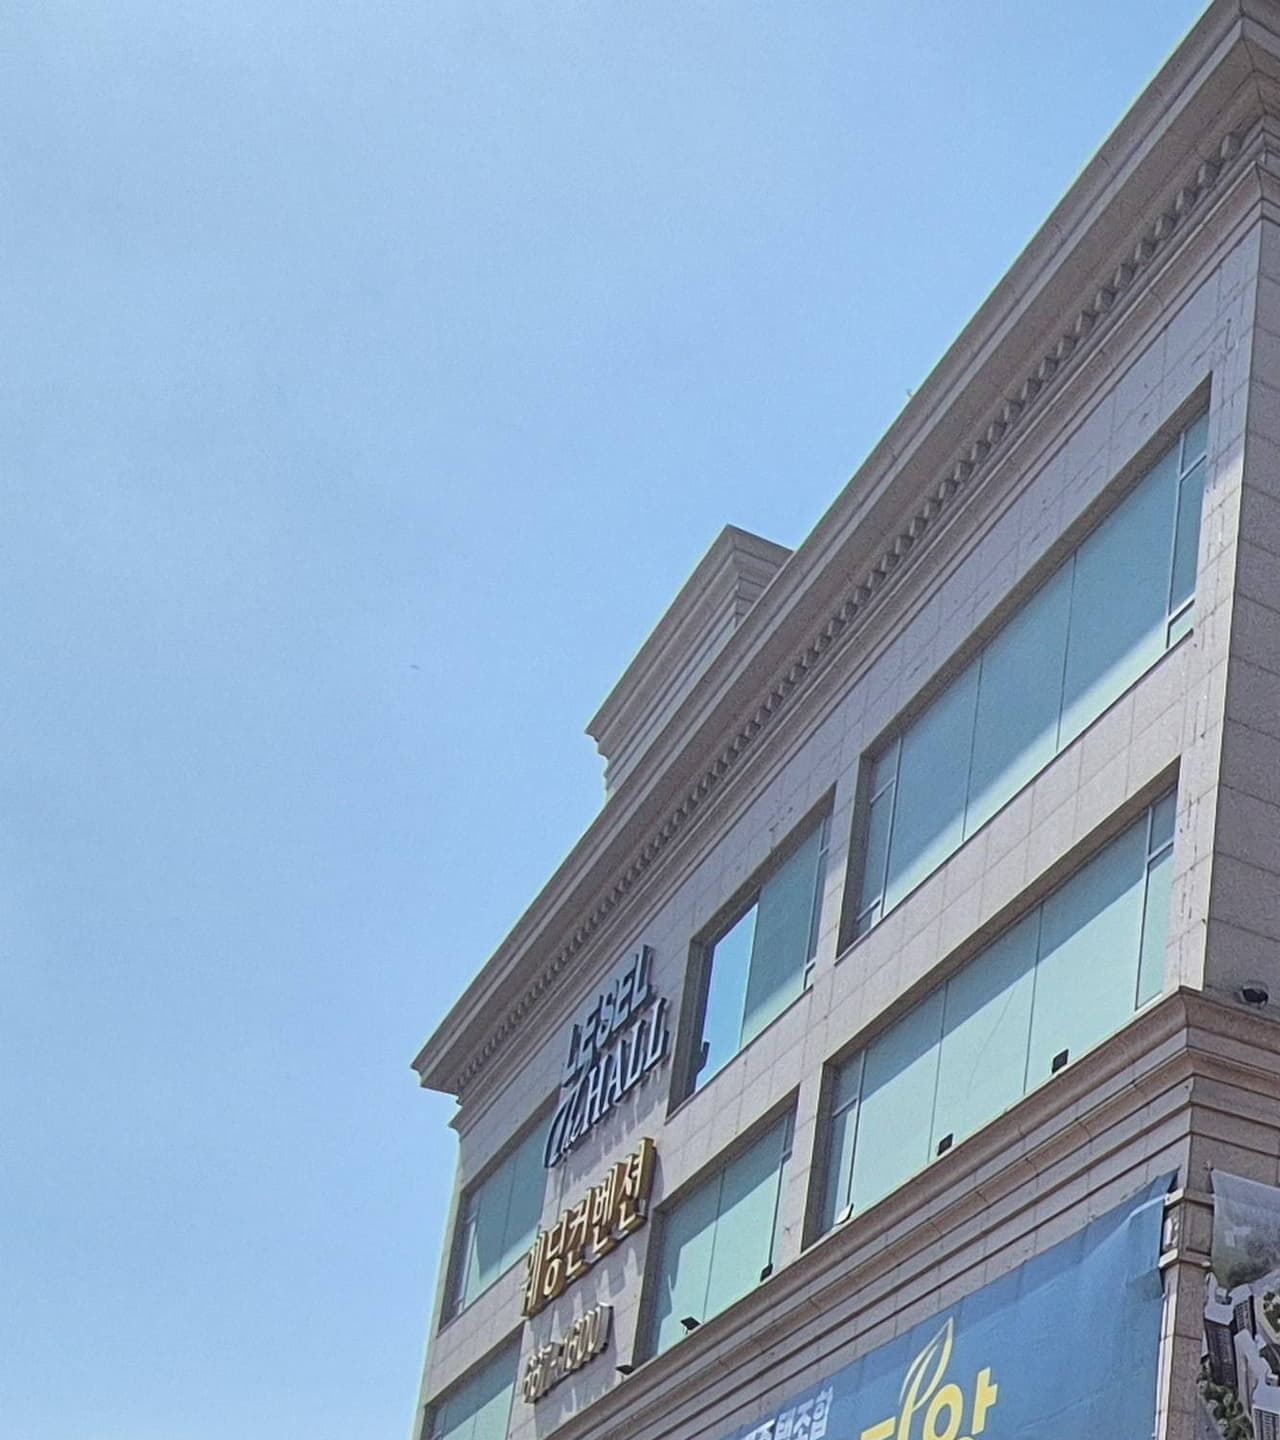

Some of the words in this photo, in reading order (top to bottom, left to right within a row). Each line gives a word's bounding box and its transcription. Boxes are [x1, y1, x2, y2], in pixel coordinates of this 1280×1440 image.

[562, 944, 652, 1083] LESEL
[581, 997, 669, 1136] HALL
[521, 1137, 656, 1319] 웨딩컨벤션
